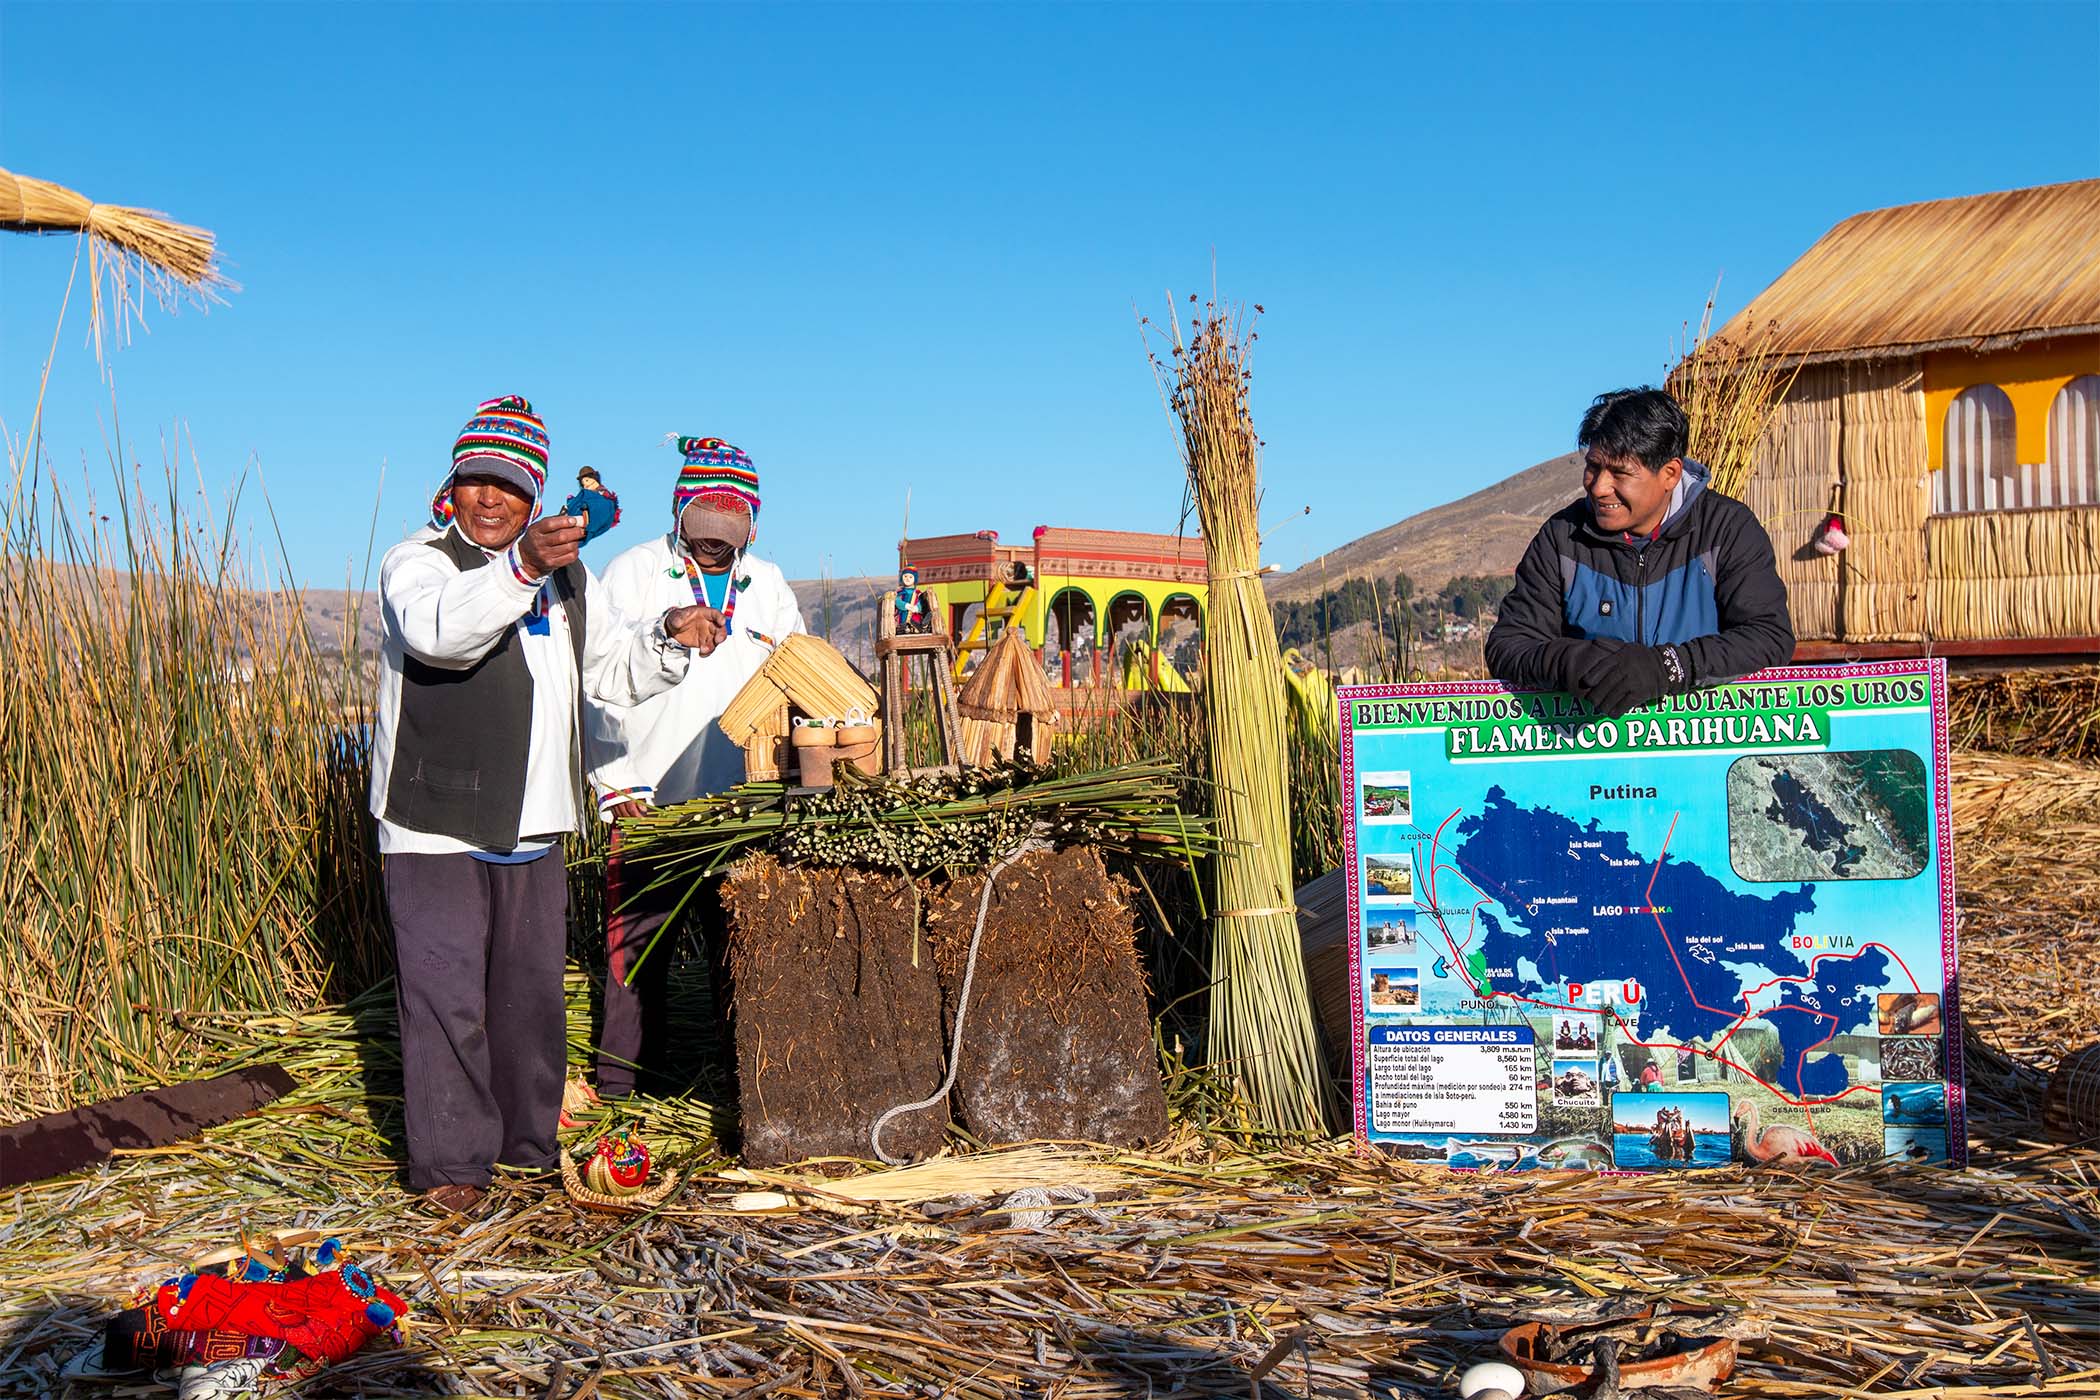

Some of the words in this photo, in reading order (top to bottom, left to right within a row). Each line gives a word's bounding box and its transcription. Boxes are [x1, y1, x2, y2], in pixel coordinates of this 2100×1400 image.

[1357, 698, 1522, 725] BIENVENIDOS
[1529, 697, 1548, 719] A
[1554, 696, 1588, 718] LA
[1656, 685, 1790, 713] FLOTANTE
[1797, 684, 1845, 707] LOS
[1851, 679, 1925, 704] UROS
[1450, 720, 1618, 754] FLAMENCO
[1626, 712, 1820, 747] PARIHUANA
[1589, 785, 1658, 800] Putina
[1593, 905, 1623, 916] LAGO
[1792, 935, 1855, 949] BOLIVIA
[1568, 977, 1642, 1004] PERÚ
[1461, 1000, 1495, 1009] PUNO
[1386, 1031, 1431, 1042] DATOS
[1434, 1030, 1517, 1042] GENERALES
[1374, 1045, 1391, 1053] Altura
[1393, 1045, 1401, 1053] de
[1480, 1045, 1501, 1053] 3,809
[1374, 1054, 1403, 1063] Superficie
[1420, 1054, 1430, 1062] del
[1431, 1054, 1444, 1064] lago
[1497, 1055, 1518, 1063] 8,560
[1374, 1063, 1391, 1073] Largo
[1408, 1063, 1417, 1071] del
[1418, 1063, 1432, 1073] lago
[1504, 1064, 1518, 1072] 165
[1520, 1064, 1532, 1072] km
[1374, 1073, 1393, 1081] Ancho
[1395, 1073, 1409, 1081] total
[1410, 1073, 1419, 1081] del
[1420, 1073, 1434, 1083] lago
[1375, 1082, 1410, 1090] Profundidad
[1467, 1084, 1478, 1092] por
[1509, 1083, 1523, 1091] 274
[1394, 1100, 1402, 1108] de
[1402, 1102, 1418, 1110] puno
[1557, 1098, 1596, 1106] Chucuito
[1375, 1110, 1391, 1119] Lago
[1391, 1111, 1411, 1119] mayor
[1498, 1111, 1519, 1119] 4,580
[1520, 1111, 1533, 1119] km
[1376, 1119, 1391, 1129] Lago
[1521, 1121, 1534, 1129] km
